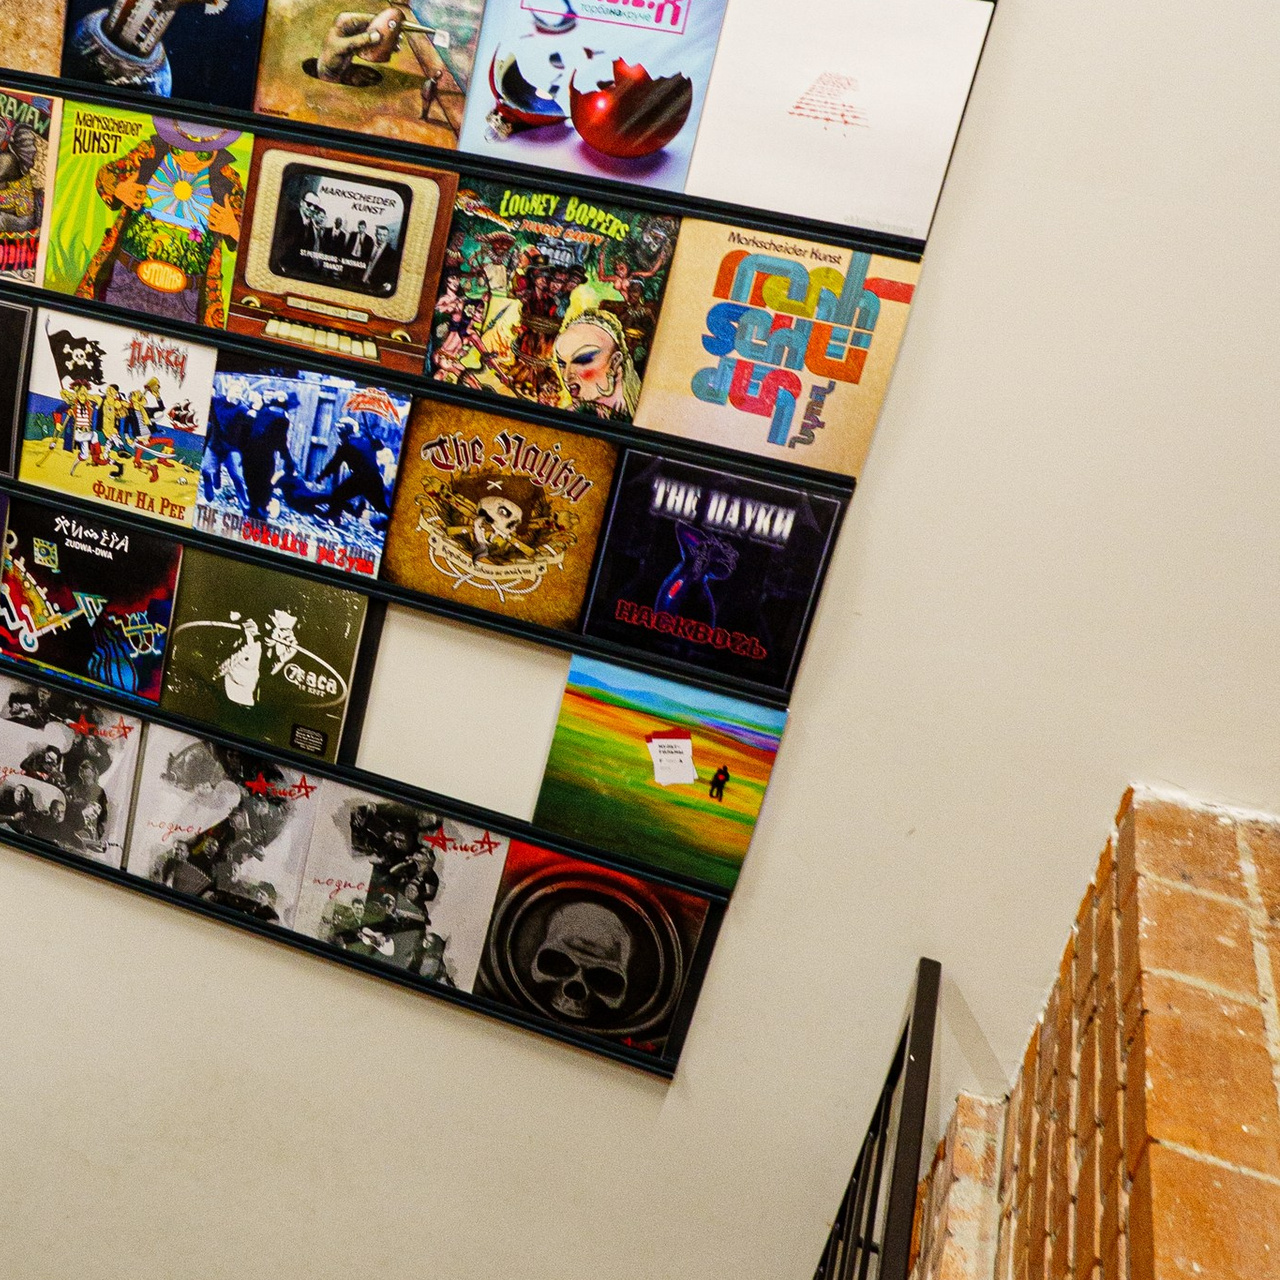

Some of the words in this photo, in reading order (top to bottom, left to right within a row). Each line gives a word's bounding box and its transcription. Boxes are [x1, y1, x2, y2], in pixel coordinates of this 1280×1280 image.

[73, 128, 122, 154] KUNST
[320, 185, 397, 208] MARKSCHEIDER
[351, 203, 386, 215] KUNST
[500, 190, 560, 217] LOONEY
[564, 196, 630, 241] BOPPERS
[727, 231, 808, 258] Markscheider
[810, 248, 842, 265] Kunst
[420, 430, 485, 472] The
[92, 480, 132, 506] ФЛАГ
[158, 496, 186, 520] РЕЕ
[653, 478, 702, 519] THE
[196, 504, 219, 528] THE
[64, 538, 114, 560] ZUDWA-DWA
